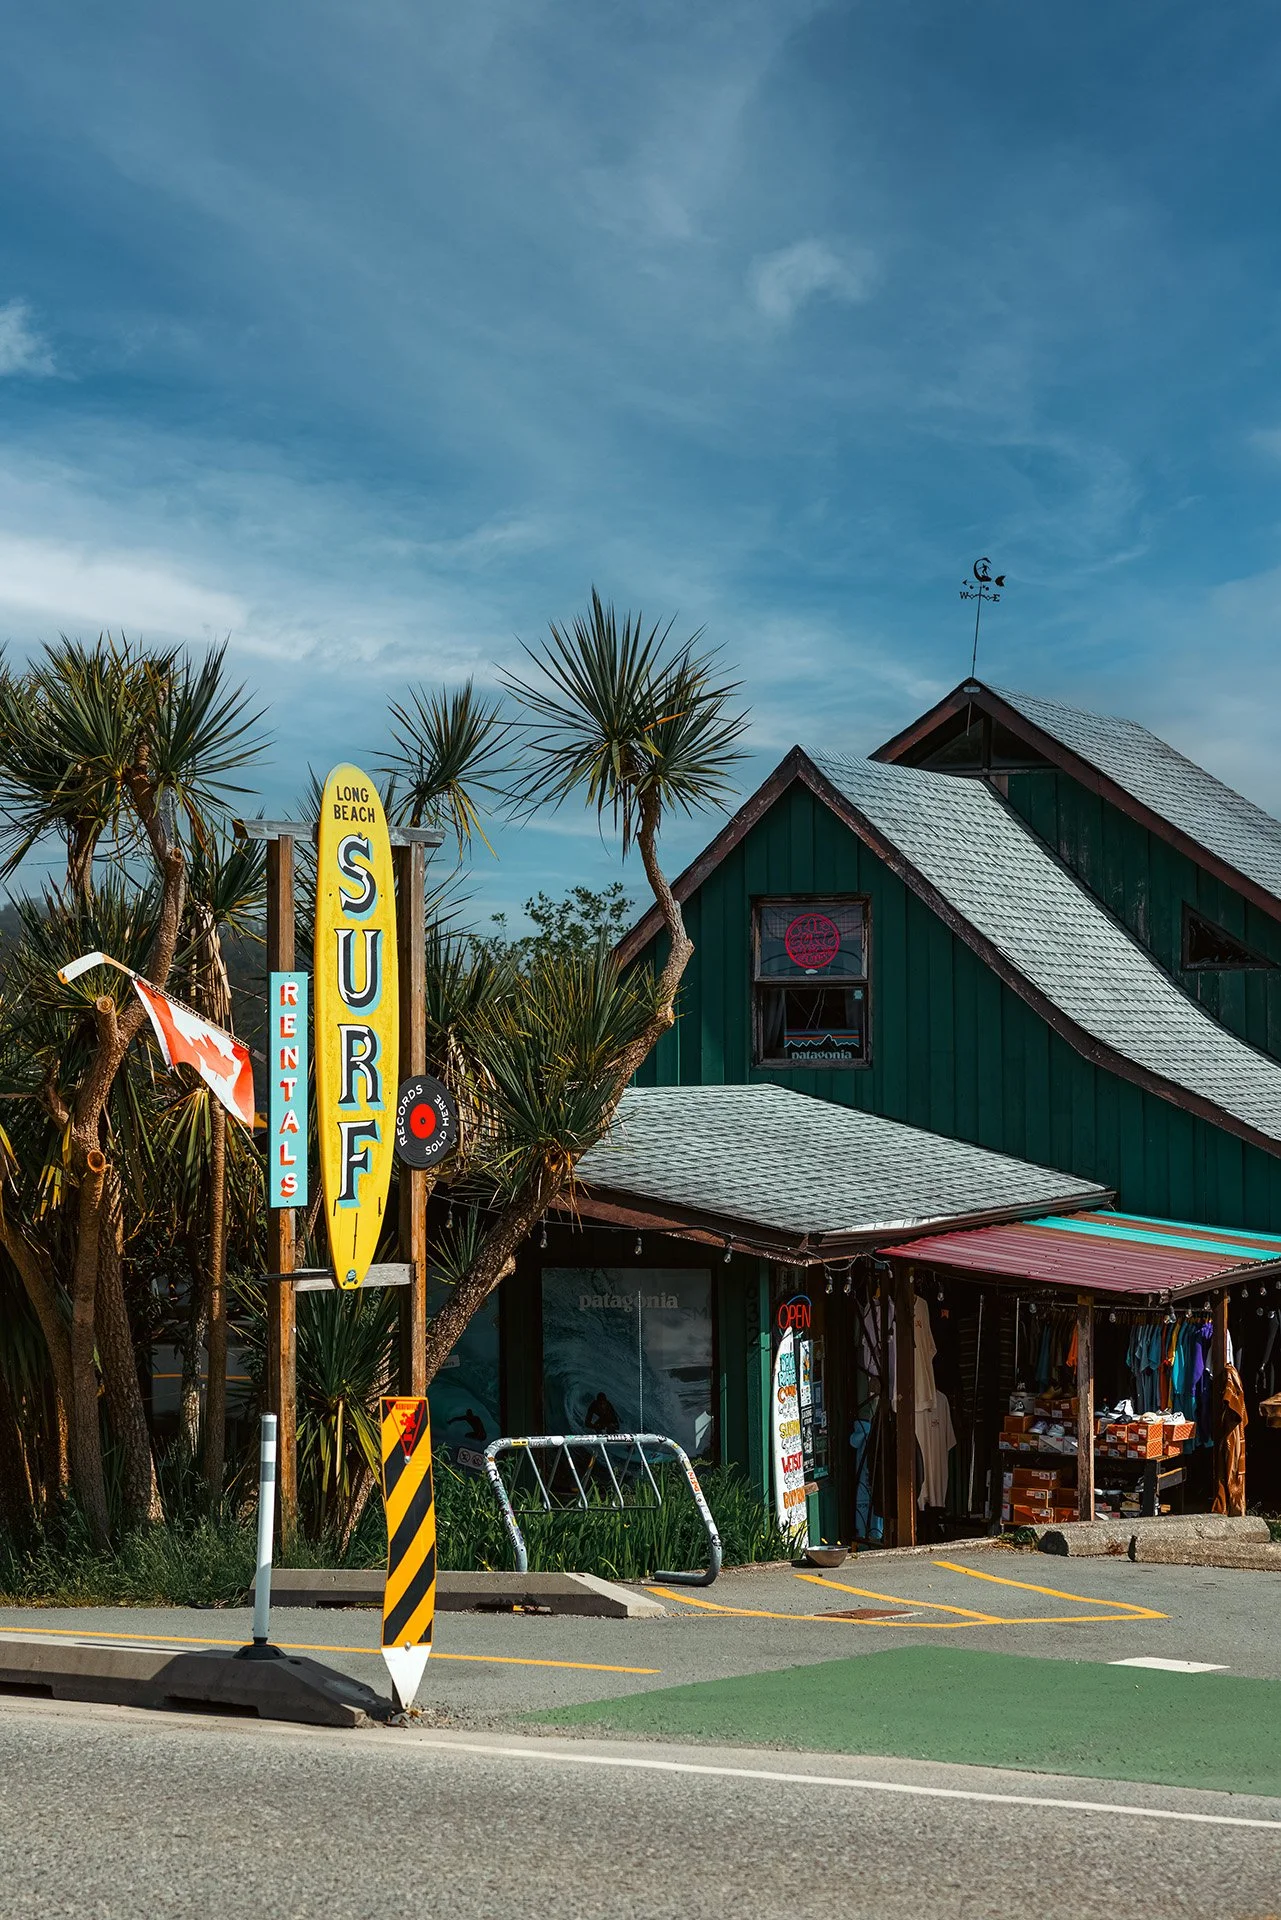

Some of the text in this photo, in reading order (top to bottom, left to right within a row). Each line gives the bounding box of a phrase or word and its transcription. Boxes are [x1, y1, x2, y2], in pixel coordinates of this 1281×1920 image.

[959, 591, 969, 600] W
[992, 593, 1001, 602] E
[336, 785, 370, 803] LONG
[333, 803, 376, 823] BEACH
[334, 833, 384, 1208] SURF
[791, 1049, 852, 1060] patagonia
[279, 981, 300, 1198] RENTALS
[396, 1084, 424, 1147] RECORDS
[425, 1094, 450, 1156] SOLD HERE
[578, 1291, 680, 1312] patagonia
[777, 1303, 812, 1330] OPEN
